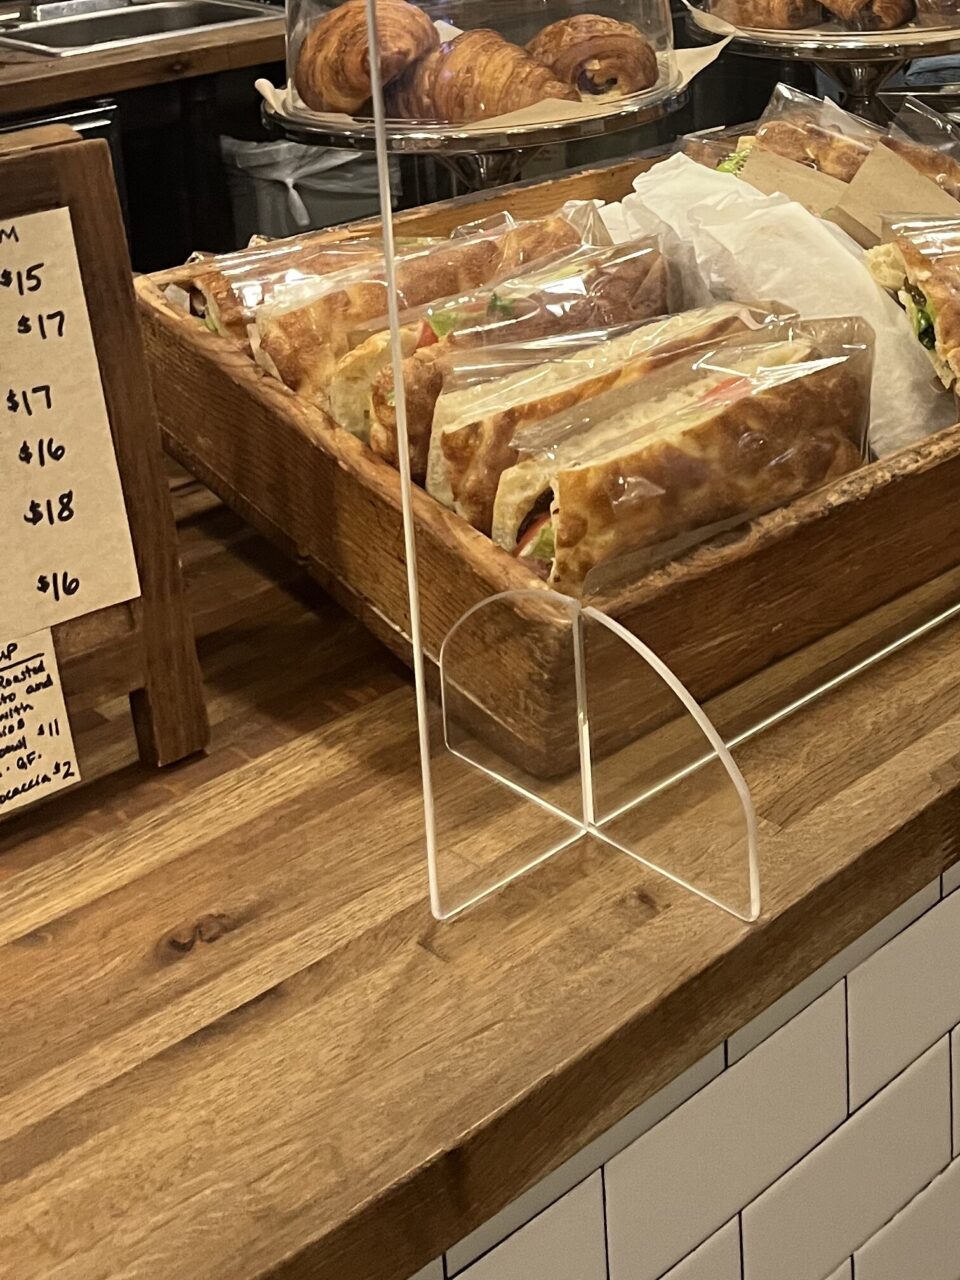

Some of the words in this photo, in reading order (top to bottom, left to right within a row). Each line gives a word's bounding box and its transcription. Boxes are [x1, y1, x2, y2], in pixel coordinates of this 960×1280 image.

[0, 263, 44, 295] $15
[17, 310, 65, 339] $17
[7, 385, 51, 416] $17
[19, 437, 65, 467] $16
[24, 489, 74, 525] $18
[37, 571, 80, 601] $16
[26, 674, 53, 695] and
[53, 761, 75, 780] $2
